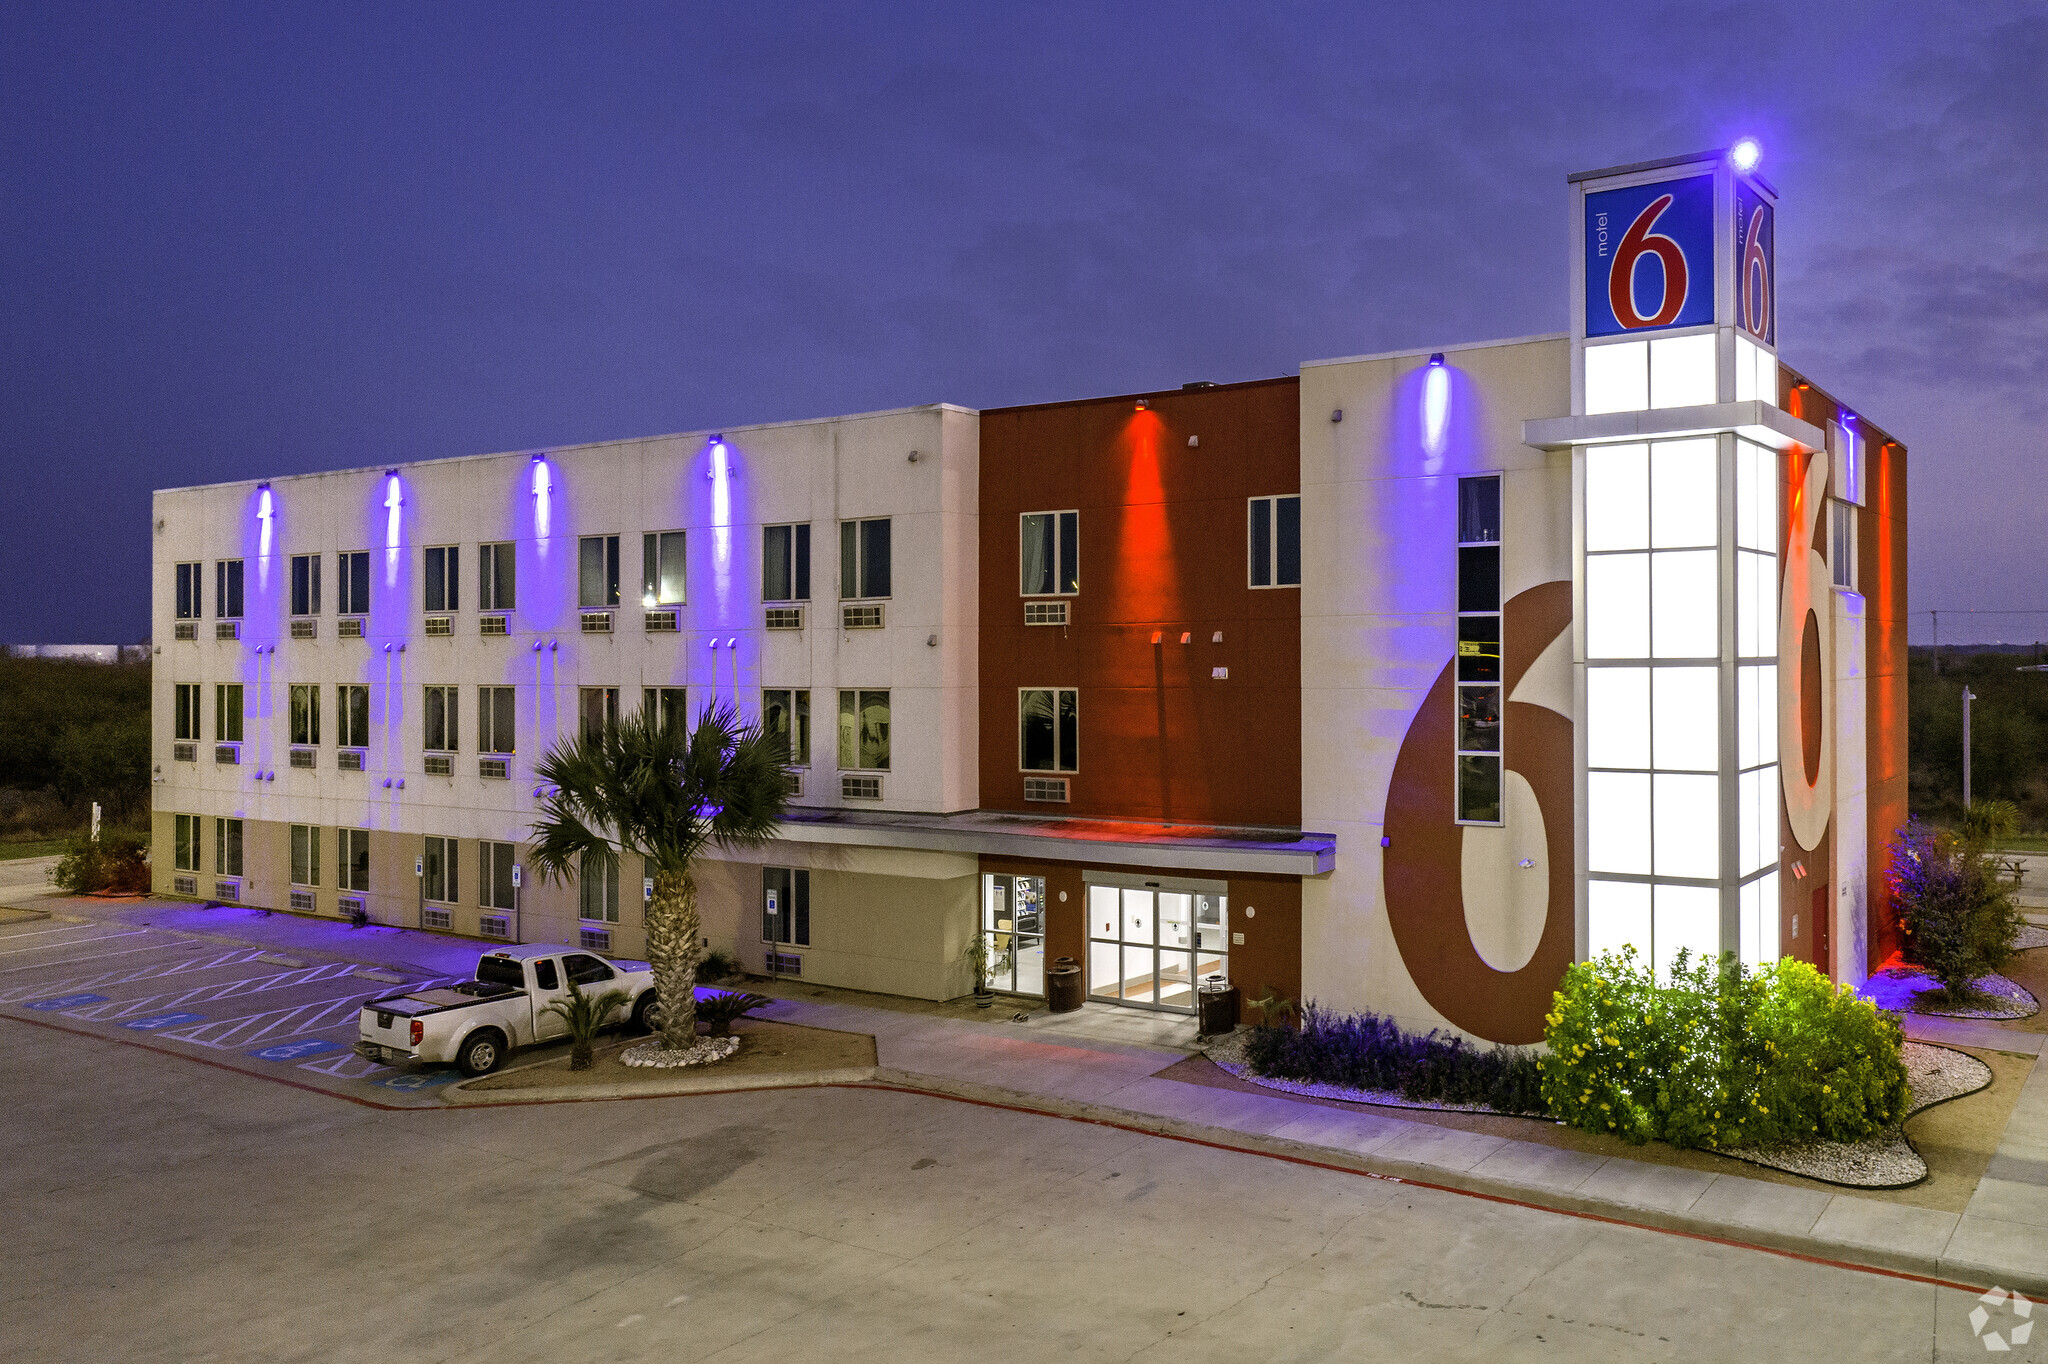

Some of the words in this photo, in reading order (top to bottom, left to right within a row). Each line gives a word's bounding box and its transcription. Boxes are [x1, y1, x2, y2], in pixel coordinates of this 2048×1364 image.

[1596, 212, 1608, 257] motel
[1608, 193, 1689, 329] 6
[1742, 204, 1770, 341] 6
[1780, 449, 1831, 851] 6
[1383, 580, 1574, 1045] 6
